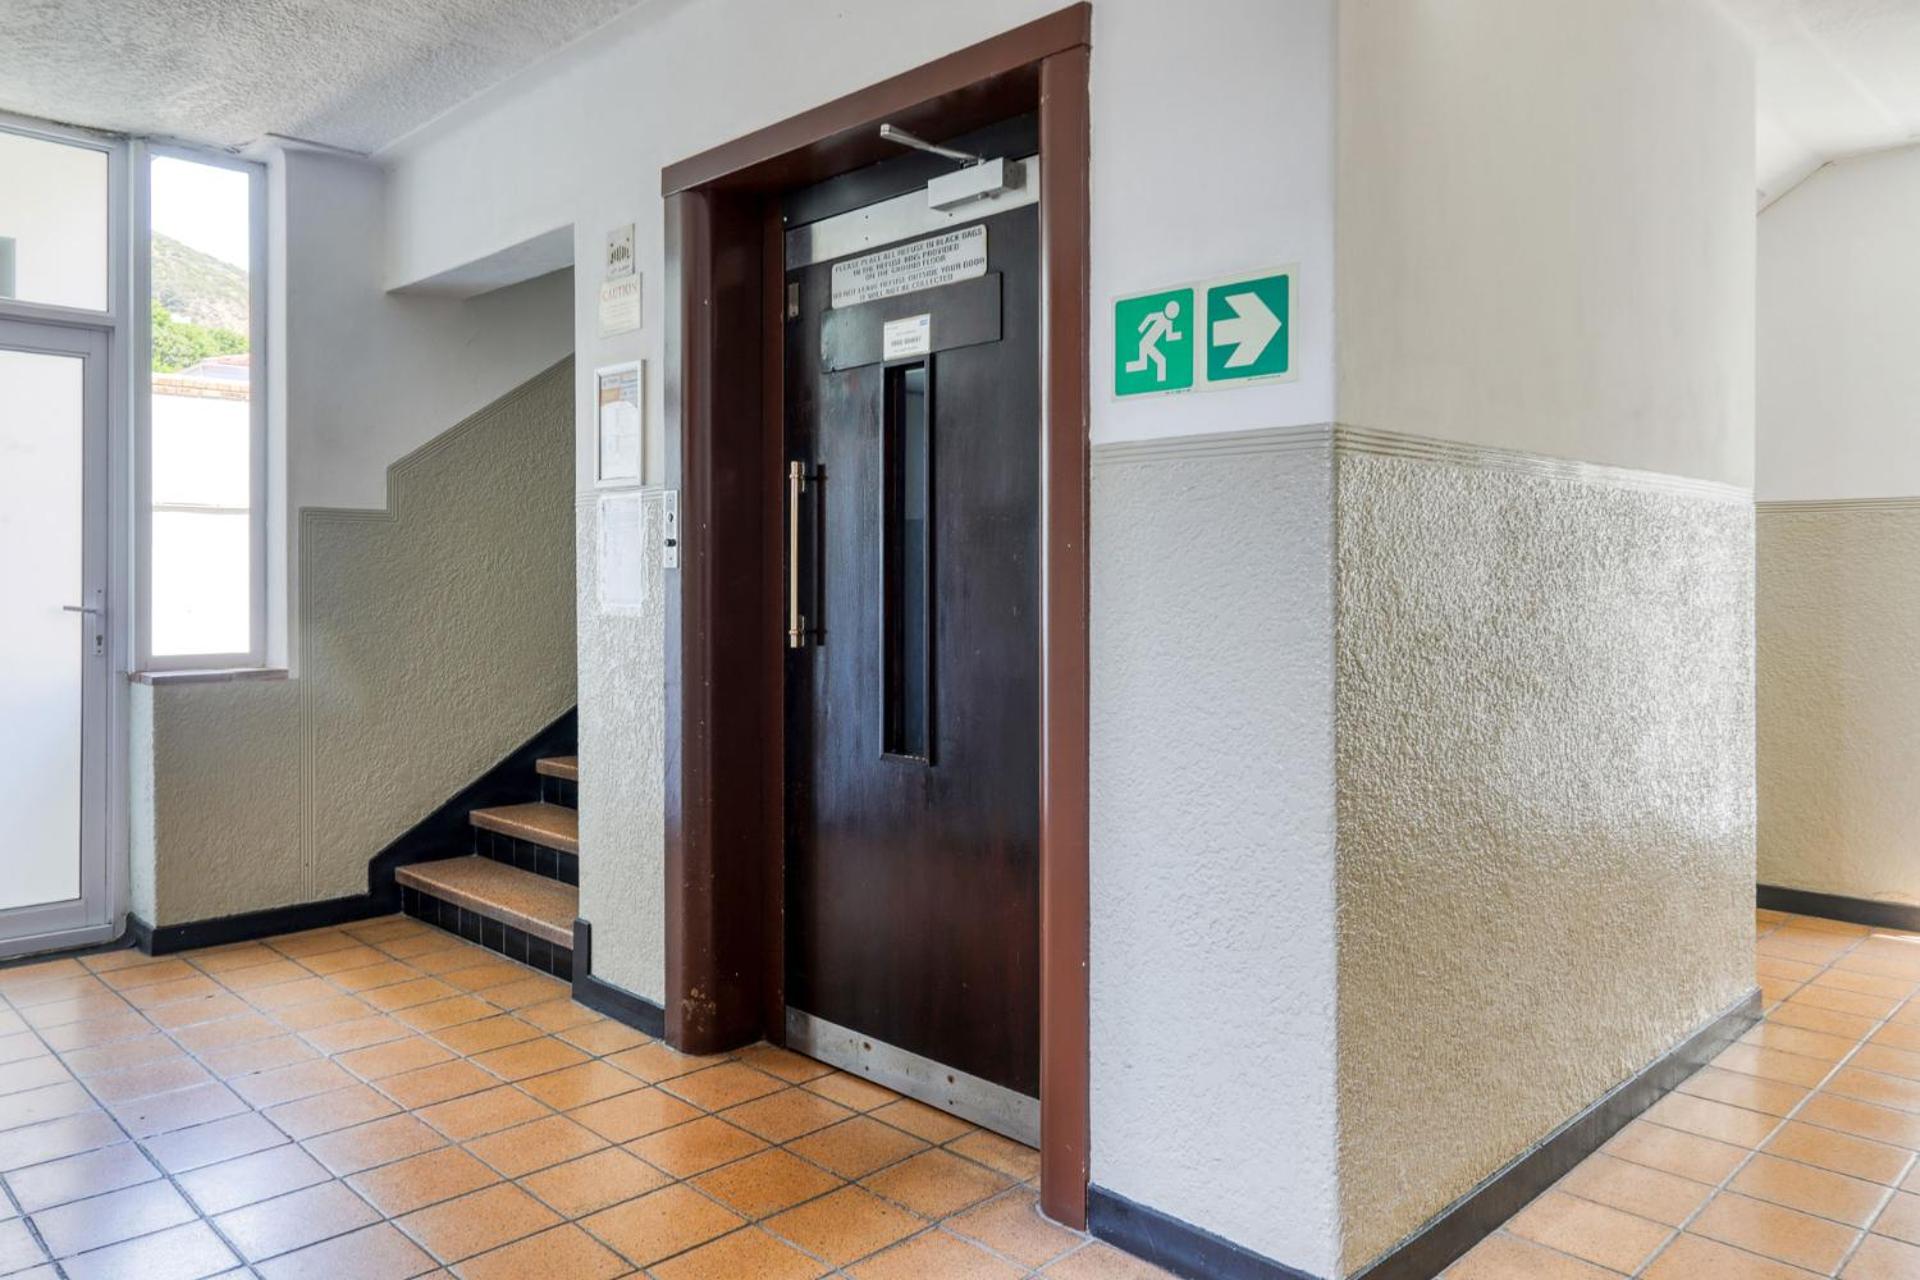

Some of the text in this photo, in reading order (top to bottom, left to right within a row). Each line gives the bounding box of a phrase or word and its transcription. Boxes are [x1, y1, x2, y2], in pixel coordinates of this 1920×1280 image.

[835, 228, 982, 272] PLEASE PLACE ALL REFUSE IN BLACK BAGS
[875, 258, 901, 270] REFUSE
[921, 243, 959, 258] PROVIDED
[841, 288, 856, 297] NOT
[857, 283, 877, 293] LEAVE
[879, 276, 905, 288] REFUSE
[907, 268, 937, 282] OUTSIDE
[940, 263, 961, 274] YOUR
[963, 257, 984, 269] DOOR
[890, 261, 921, 274] GROUND
[921, 255, 946, 266] FLOOR
[885, 286, 899, 294] NOT
[911, 274, 953, 289] COLLECTED
